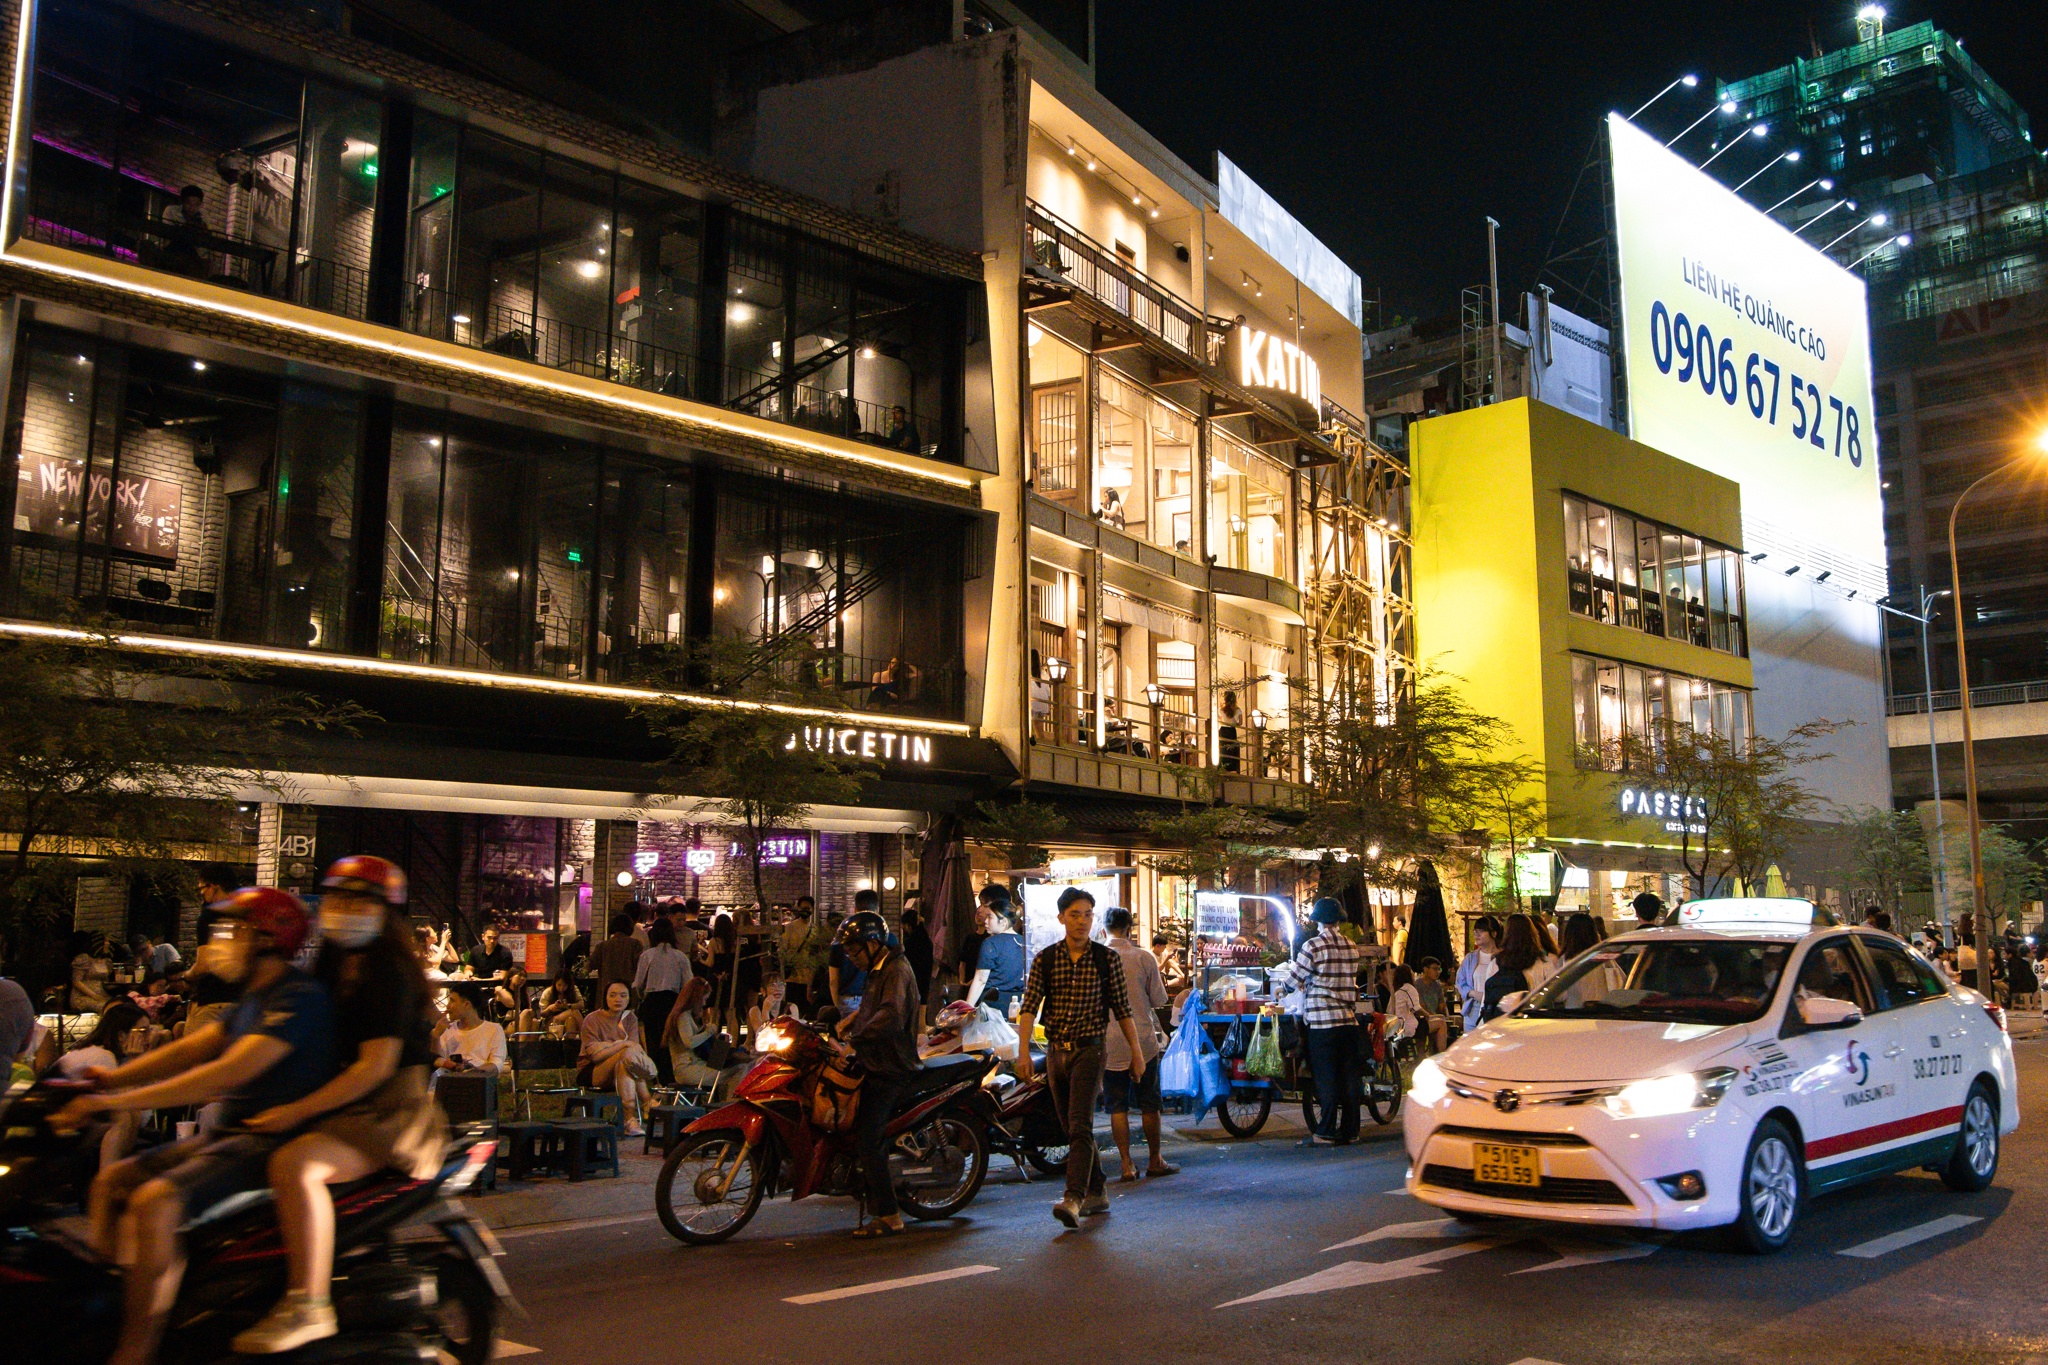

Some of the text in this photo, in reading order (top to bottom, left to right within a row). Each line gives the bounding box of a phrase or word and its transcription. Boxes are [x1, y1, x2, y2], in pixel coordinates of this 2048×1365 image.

[1682, 256, 1826, 361] LIÊN HỆ QUẢNG CÁO
[1650, 300, 1863, 468] 0906 67 52 78
[39, 462, 84, 501] NEW
[280, 835, 316, 857] 4B1
[2034, 964, 2045, 974] 82
[1492, 1147, 1520, 1165] 51G
